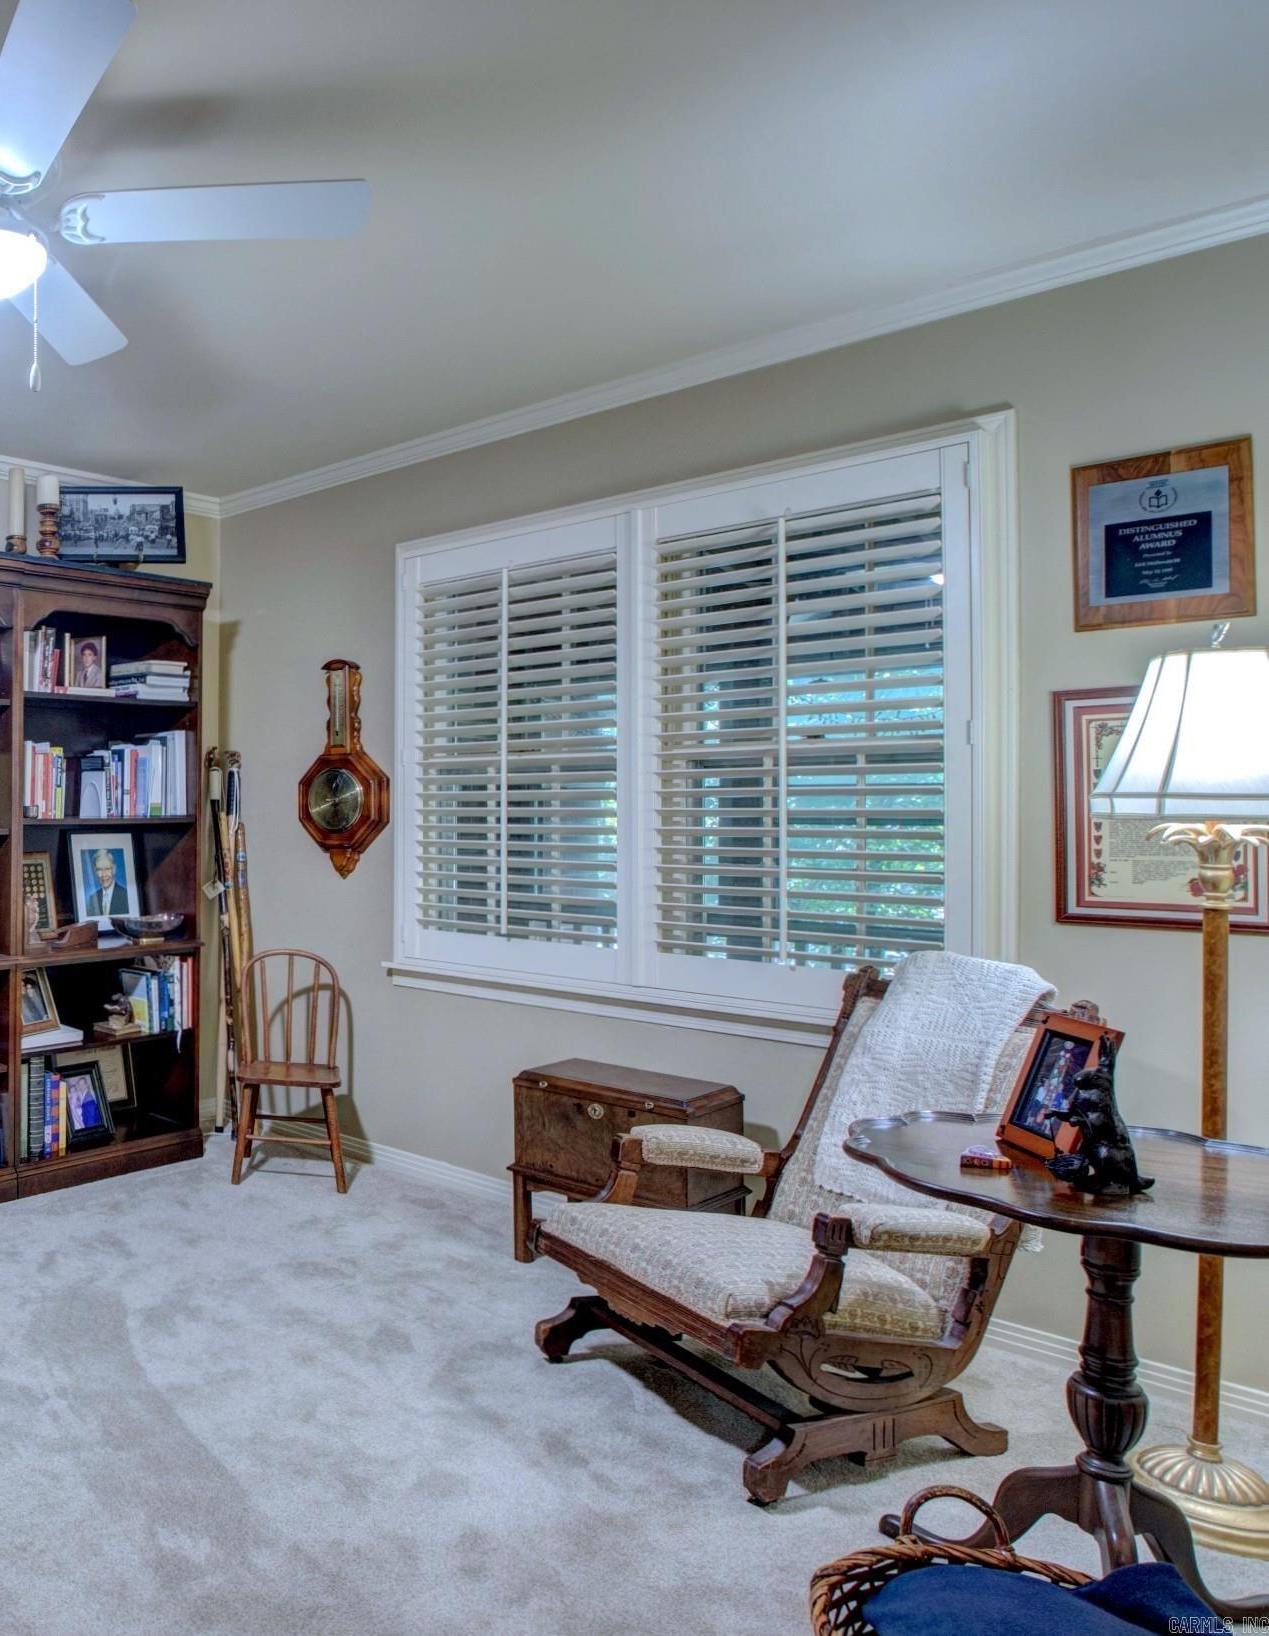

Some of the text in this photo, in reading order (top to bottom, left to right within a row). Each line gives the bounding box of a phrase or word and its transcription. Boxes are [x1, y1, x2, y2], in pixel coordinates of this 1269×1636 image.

[1118, 519, 1198, 536] DISTINGUISHED
[1132, 529, 1183, 543] ALUMNUS
[1138, 539, 1177, 551] AWARD
